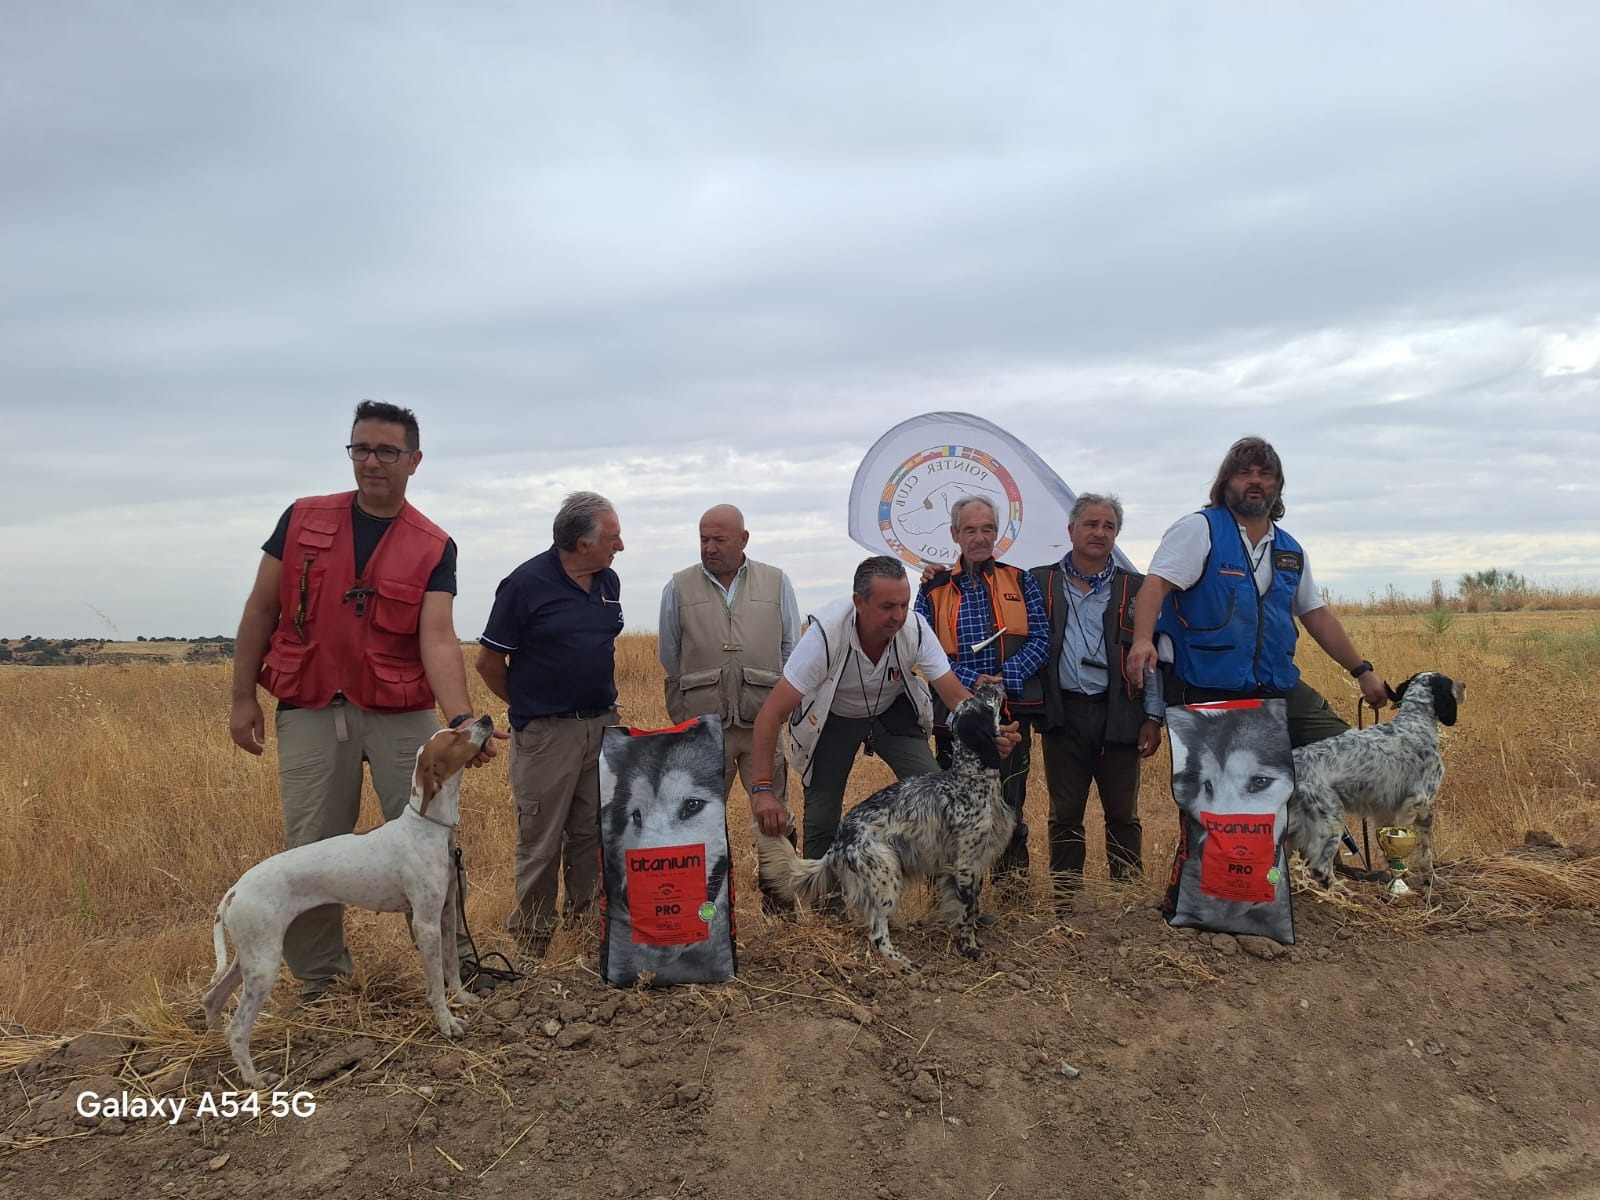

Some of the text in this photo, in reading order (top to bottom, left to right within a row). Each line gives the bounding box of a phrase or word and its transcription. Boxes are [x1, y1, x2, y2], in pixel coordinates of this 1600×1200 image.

[1206, 819, 1271, 834] titanium
[630, 855, 700, 872] titanium
[1228, 863, 1253, 875] PRO
[655, 904, 681, 917] PRO
